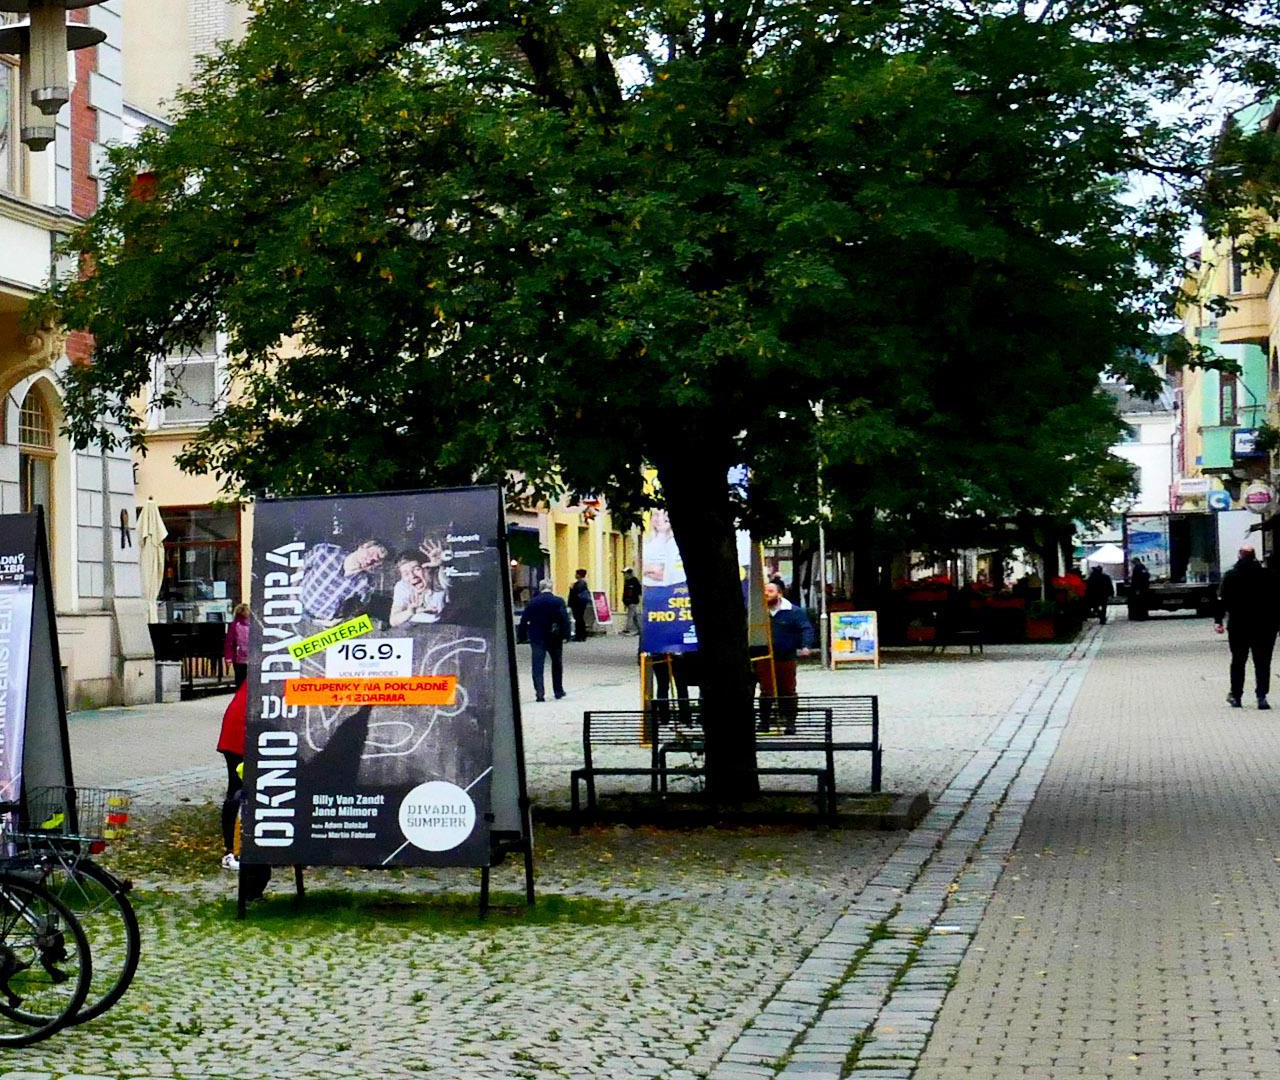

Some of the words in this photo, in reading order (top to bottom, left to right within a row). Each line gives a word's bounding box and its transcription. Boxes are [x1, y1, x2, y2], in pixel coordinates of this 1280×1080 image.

[648, 611, 676, 622] PRO
[338, 643, 402, 661] 16.9.
[292, 683, 359, 692] VSTUPENKY
[363, 683, 381, 692] NA
[384, 680, 448, 692] POKLADNĚ
[354, 693, 406, 703] ZDARMA
[254, 731, 298, 846] OKNO
[312, 795, 334, 806] Billy
[336, 795, 354, 805] Van
[356, 795, 385, 805] Zandt
[312, 807, 336, 816] Jane
[338, 807, 378, 816] Milmore
[408, 805, 466, 815] DIVADLO
